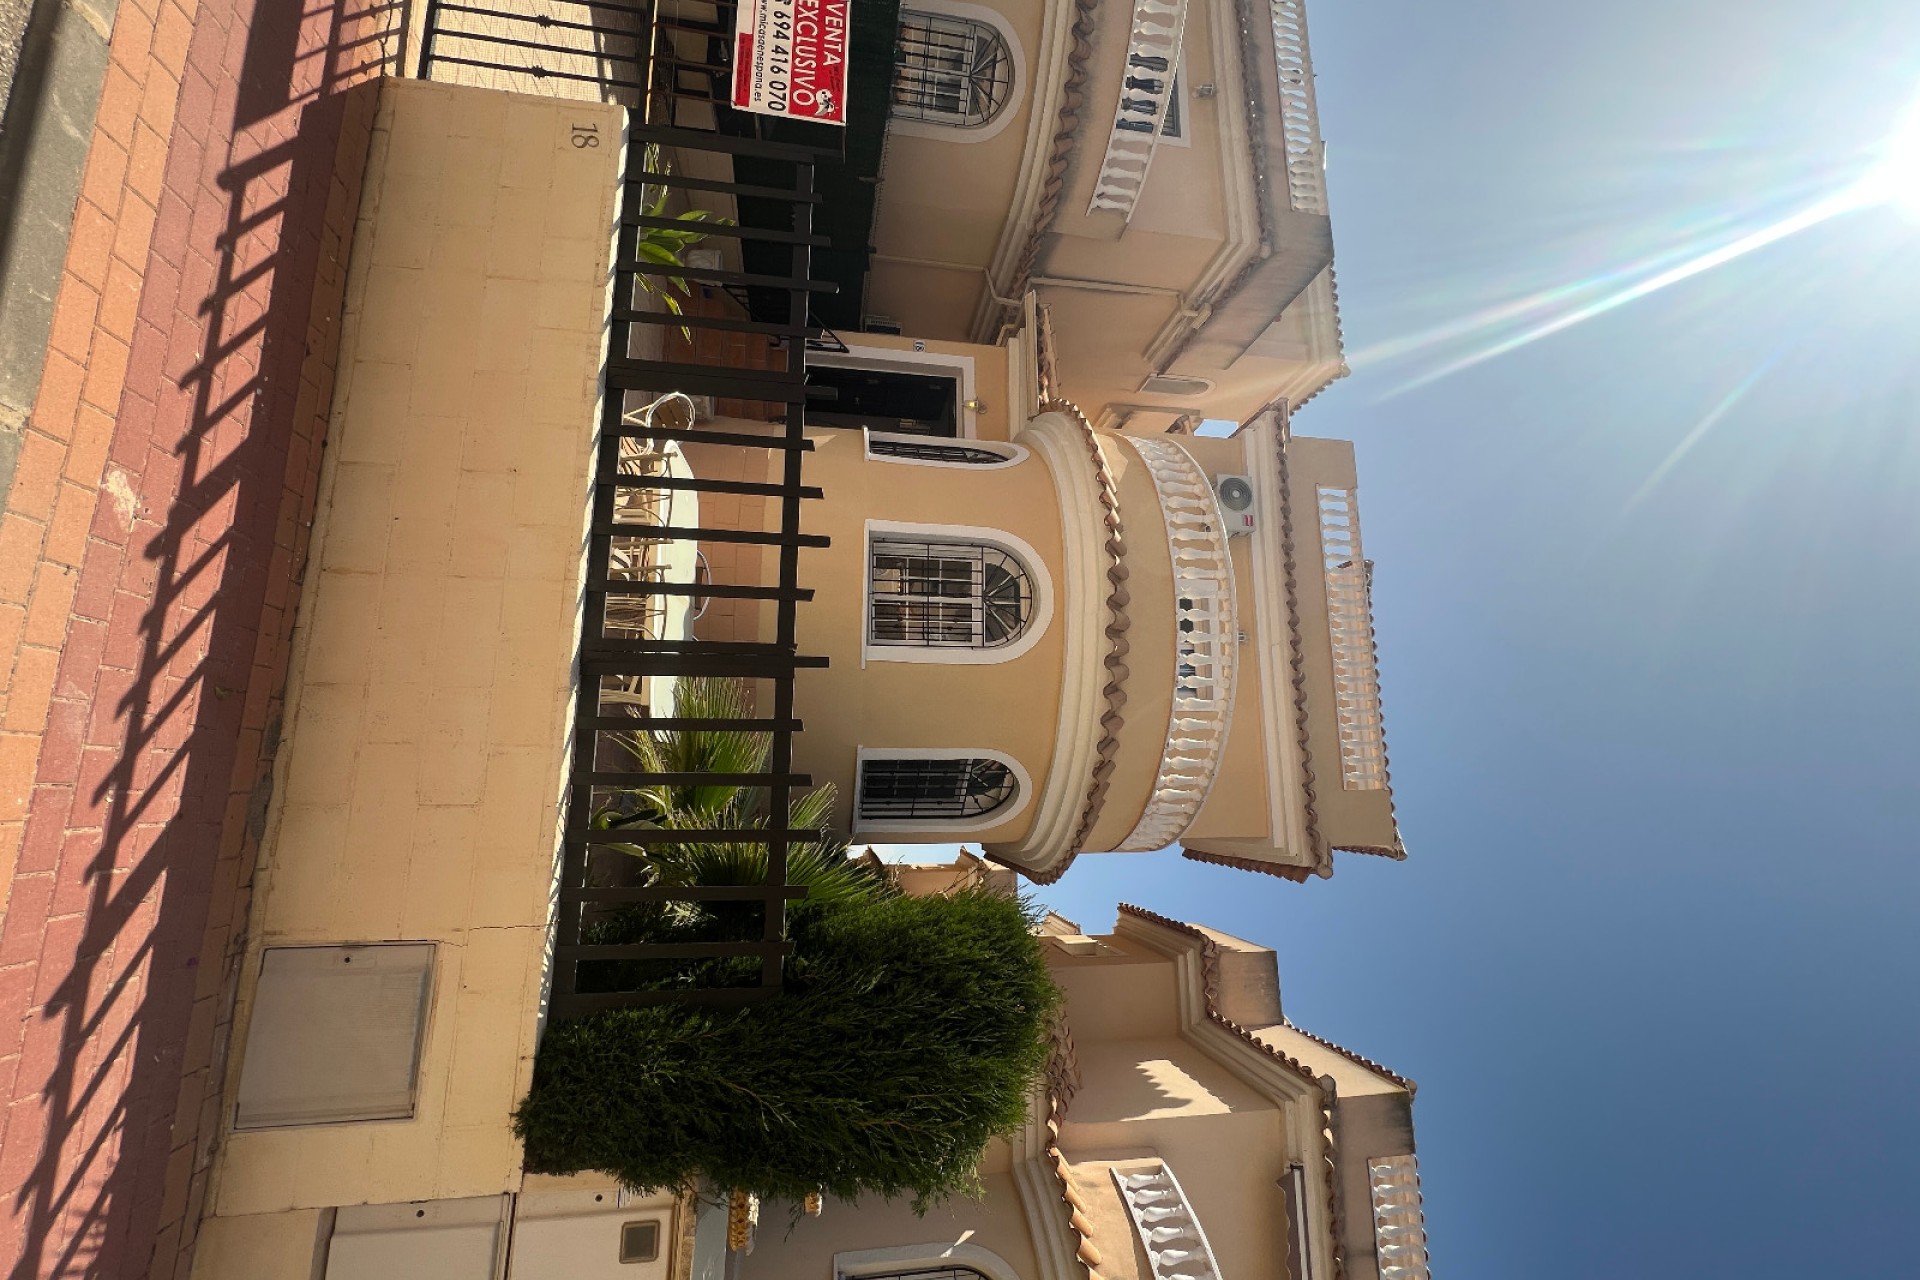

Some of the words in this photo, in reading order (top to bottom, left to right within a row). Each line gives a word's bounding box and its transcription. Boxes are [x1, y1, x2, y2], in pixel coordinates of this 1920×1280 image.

[773, 10, 791, 40] 694
[823, 3, 844, 66] VENTA
[771, 45, 789, 74] 416
[792, 0, 819, 106] EXCLUSIVO
[767, 80, 787, 111] 070
[571, 122, 600, 148] 18
